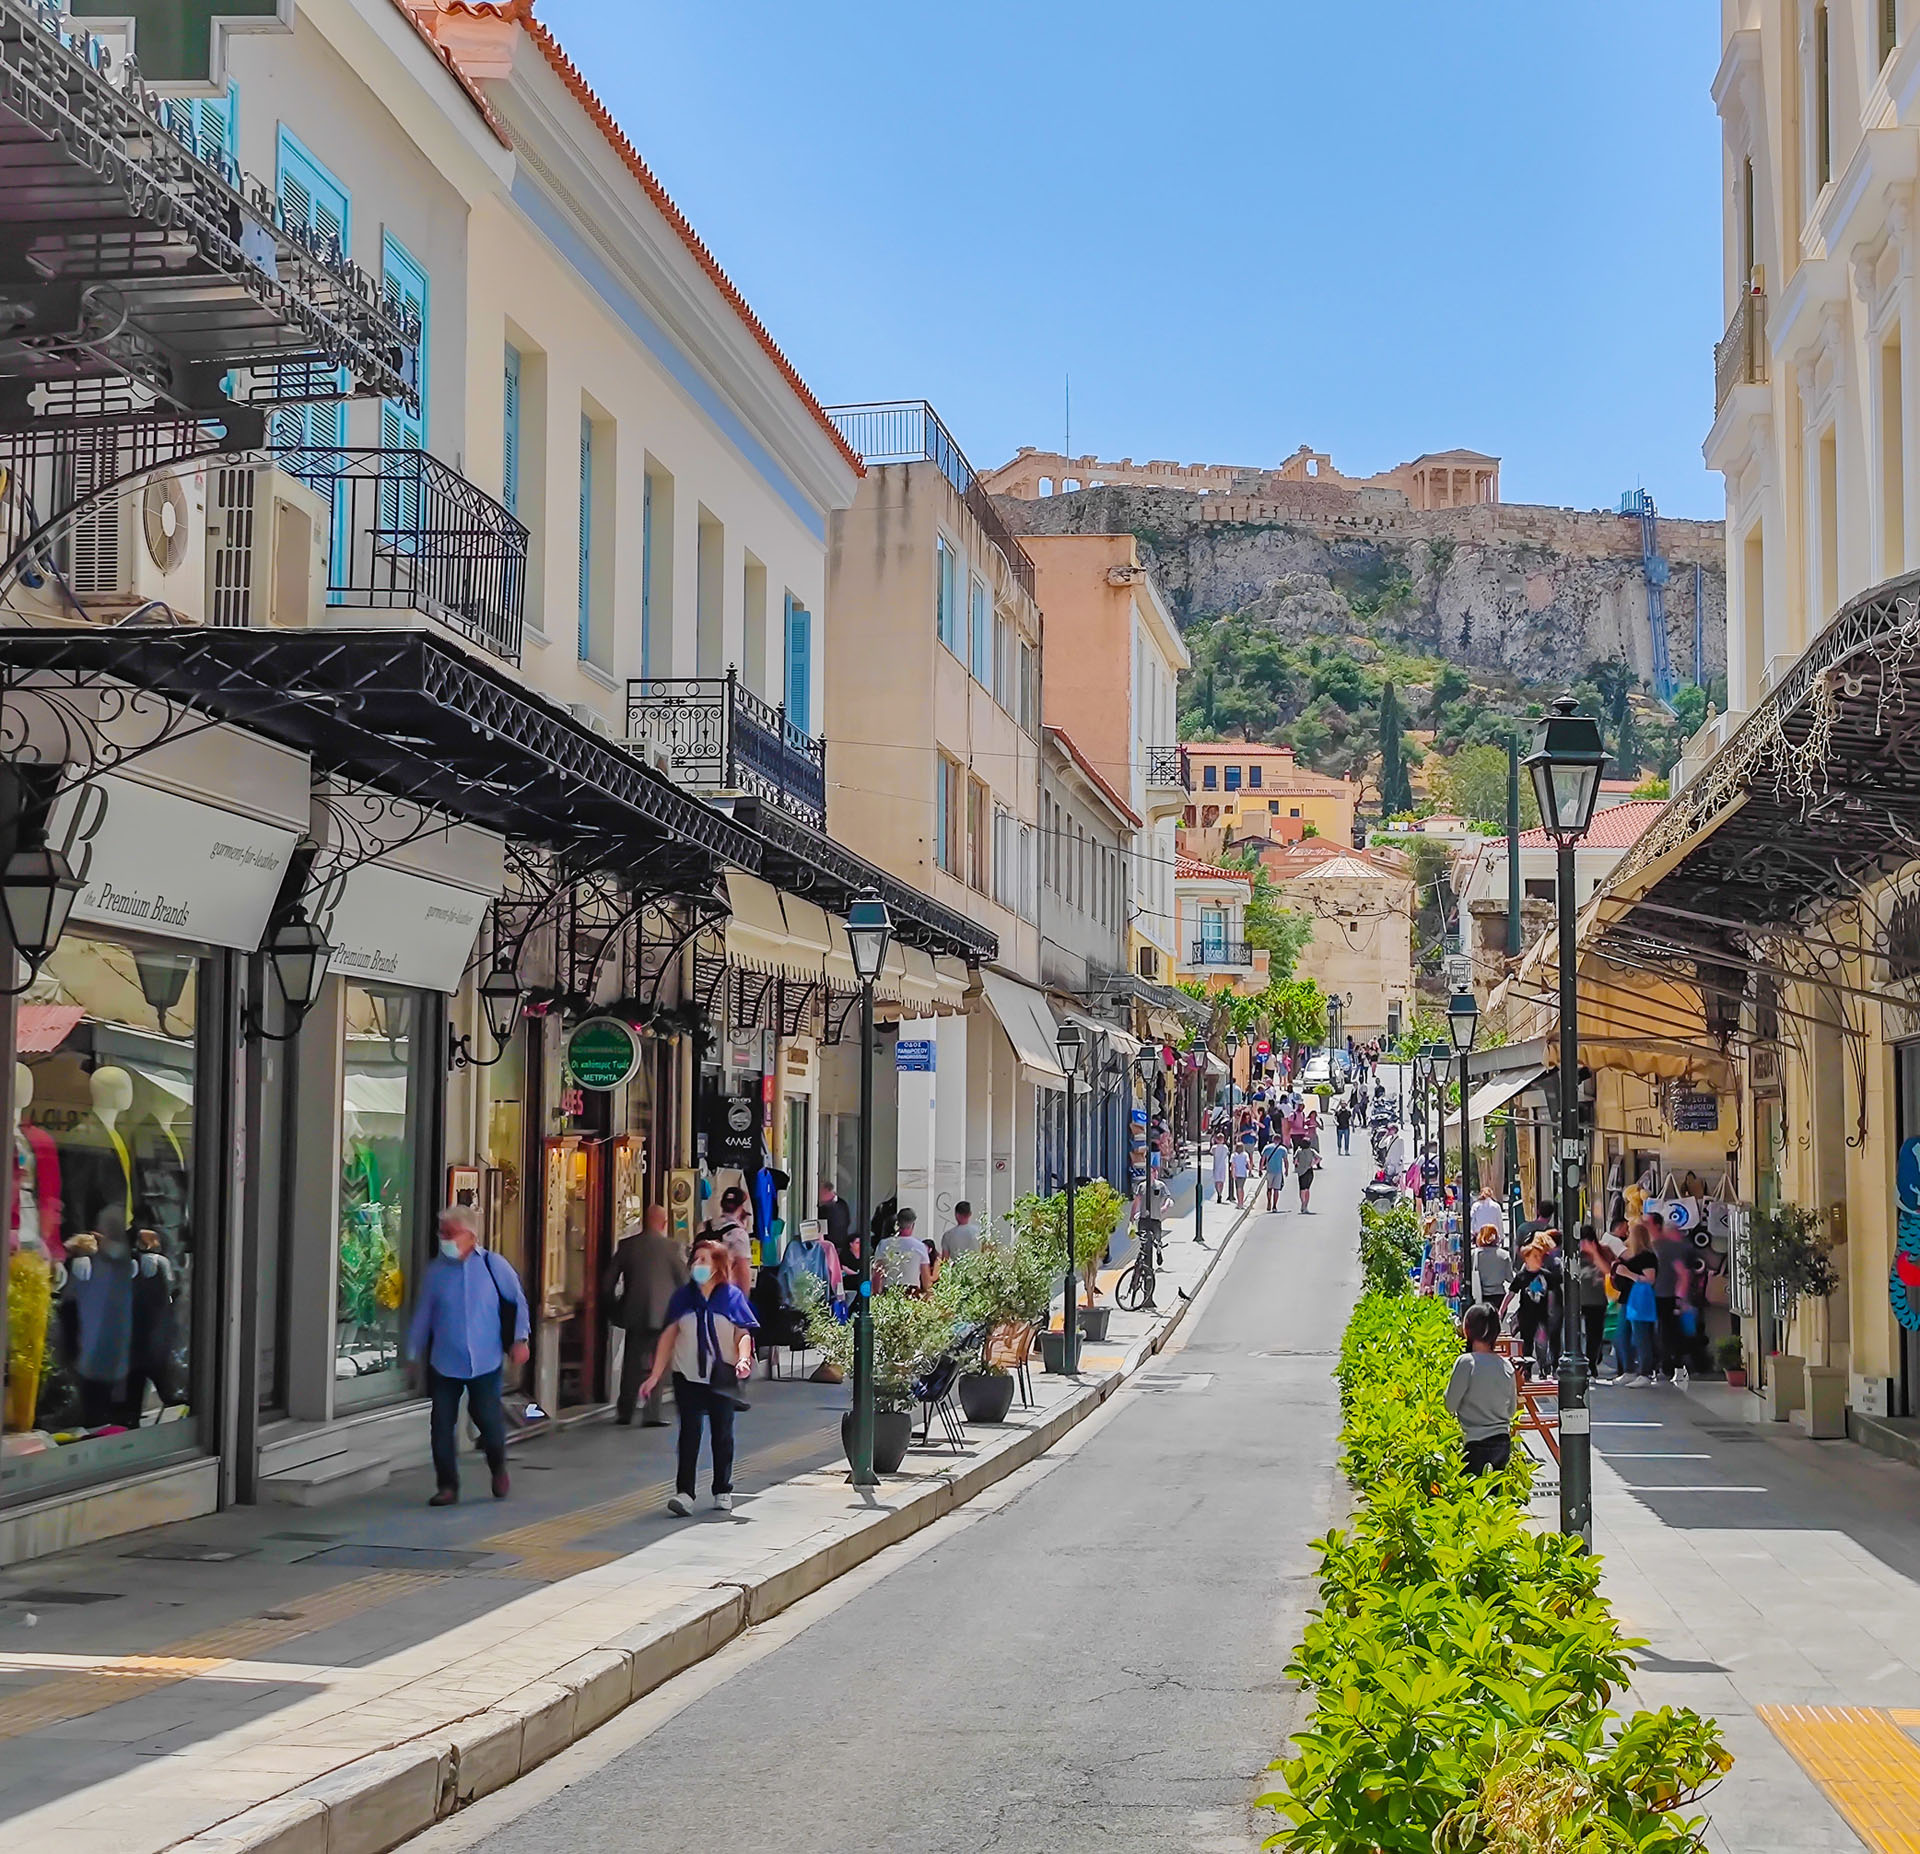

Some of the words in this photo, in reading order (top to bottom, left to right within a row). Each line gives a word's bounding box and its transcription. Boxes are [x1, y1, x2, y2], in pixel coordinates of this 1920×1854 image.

[209, 841, 280, 871] garment-fur-leather
[83, 890, 96, 907] the
[97, 882, 151, 918] Premium
[149, 895, 190, 927] Brands
[334, 942, 372, 969] Premium
[370, 949, 399, 973] Brands
